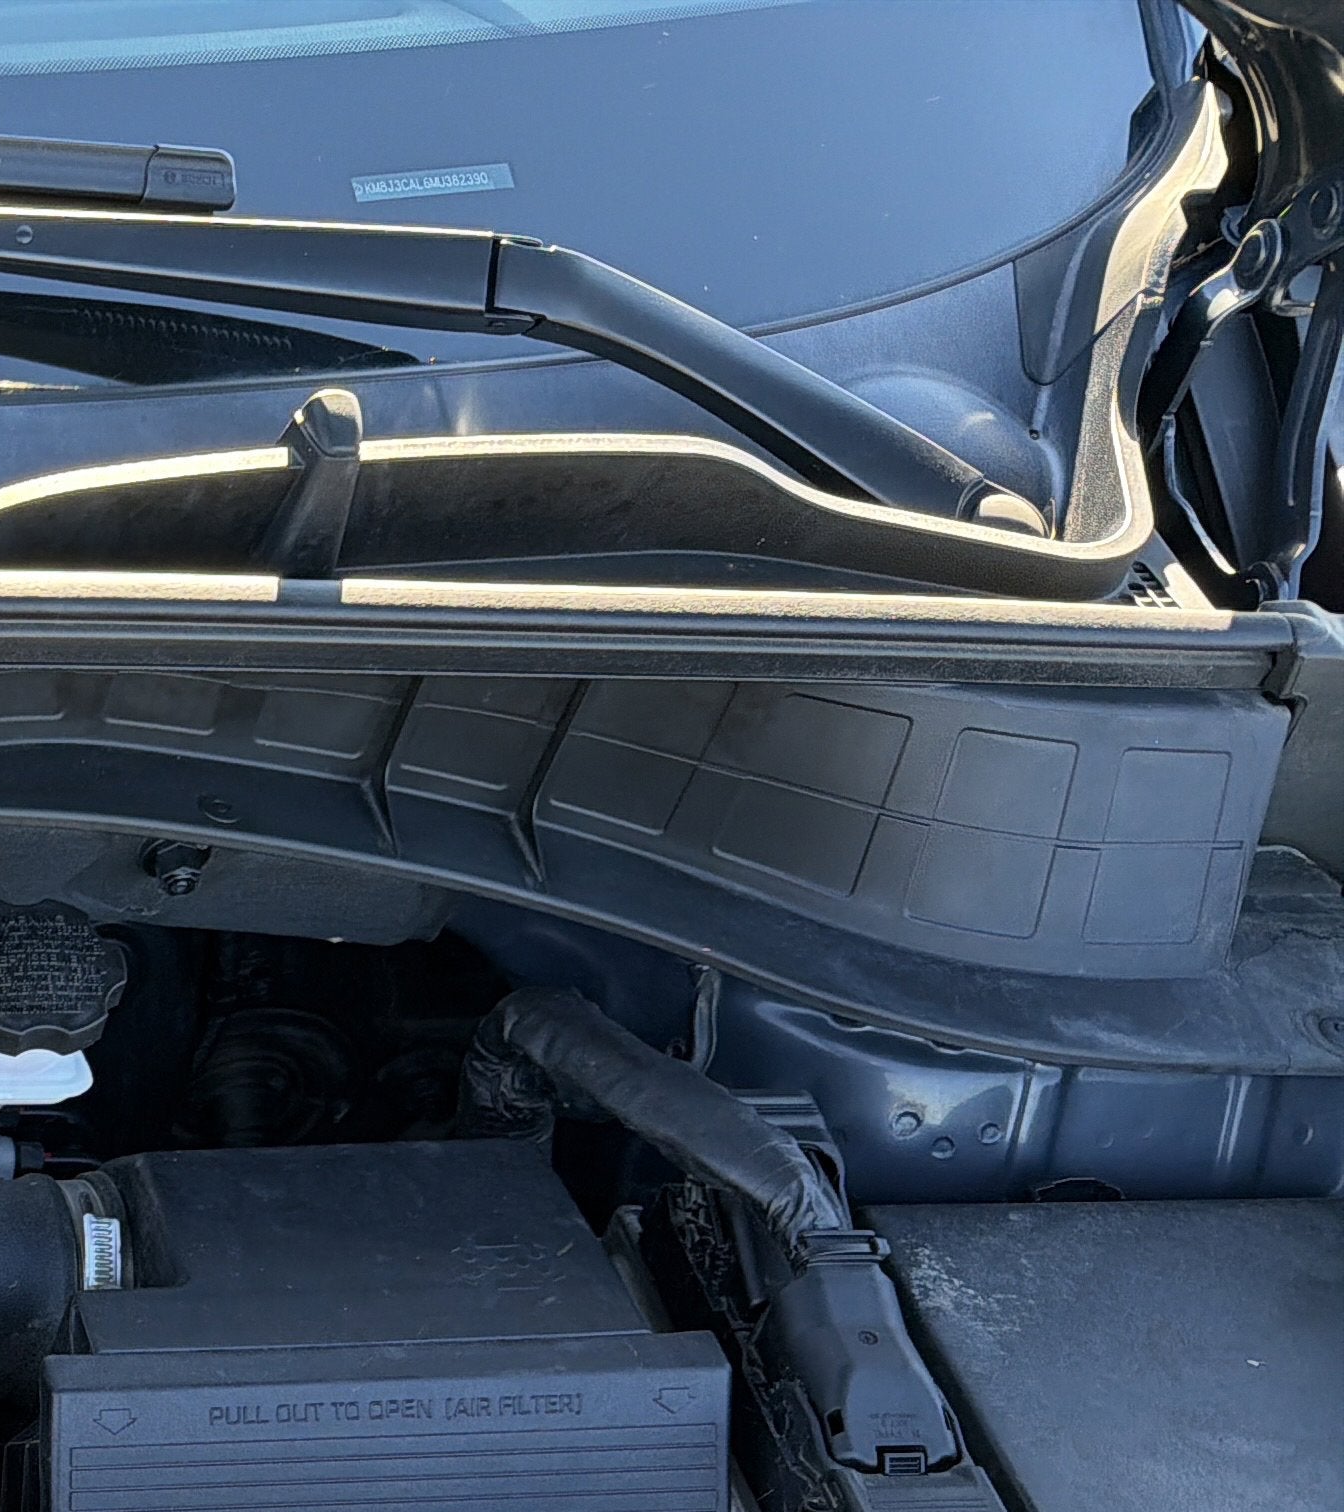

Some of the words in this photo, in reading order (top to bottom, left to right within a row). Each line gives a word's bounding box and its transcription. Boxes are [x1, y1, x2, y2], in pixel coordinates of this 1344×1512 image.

[364, 171, 488, 195] KM8J3CAL6MU382390
[208, 1405, 269, 1425] PULL
[276, 1402, 325, 1423] OUT
[331, 1401, 360, 1421] TO
[368, 1398, 432, 1420] OPEN
